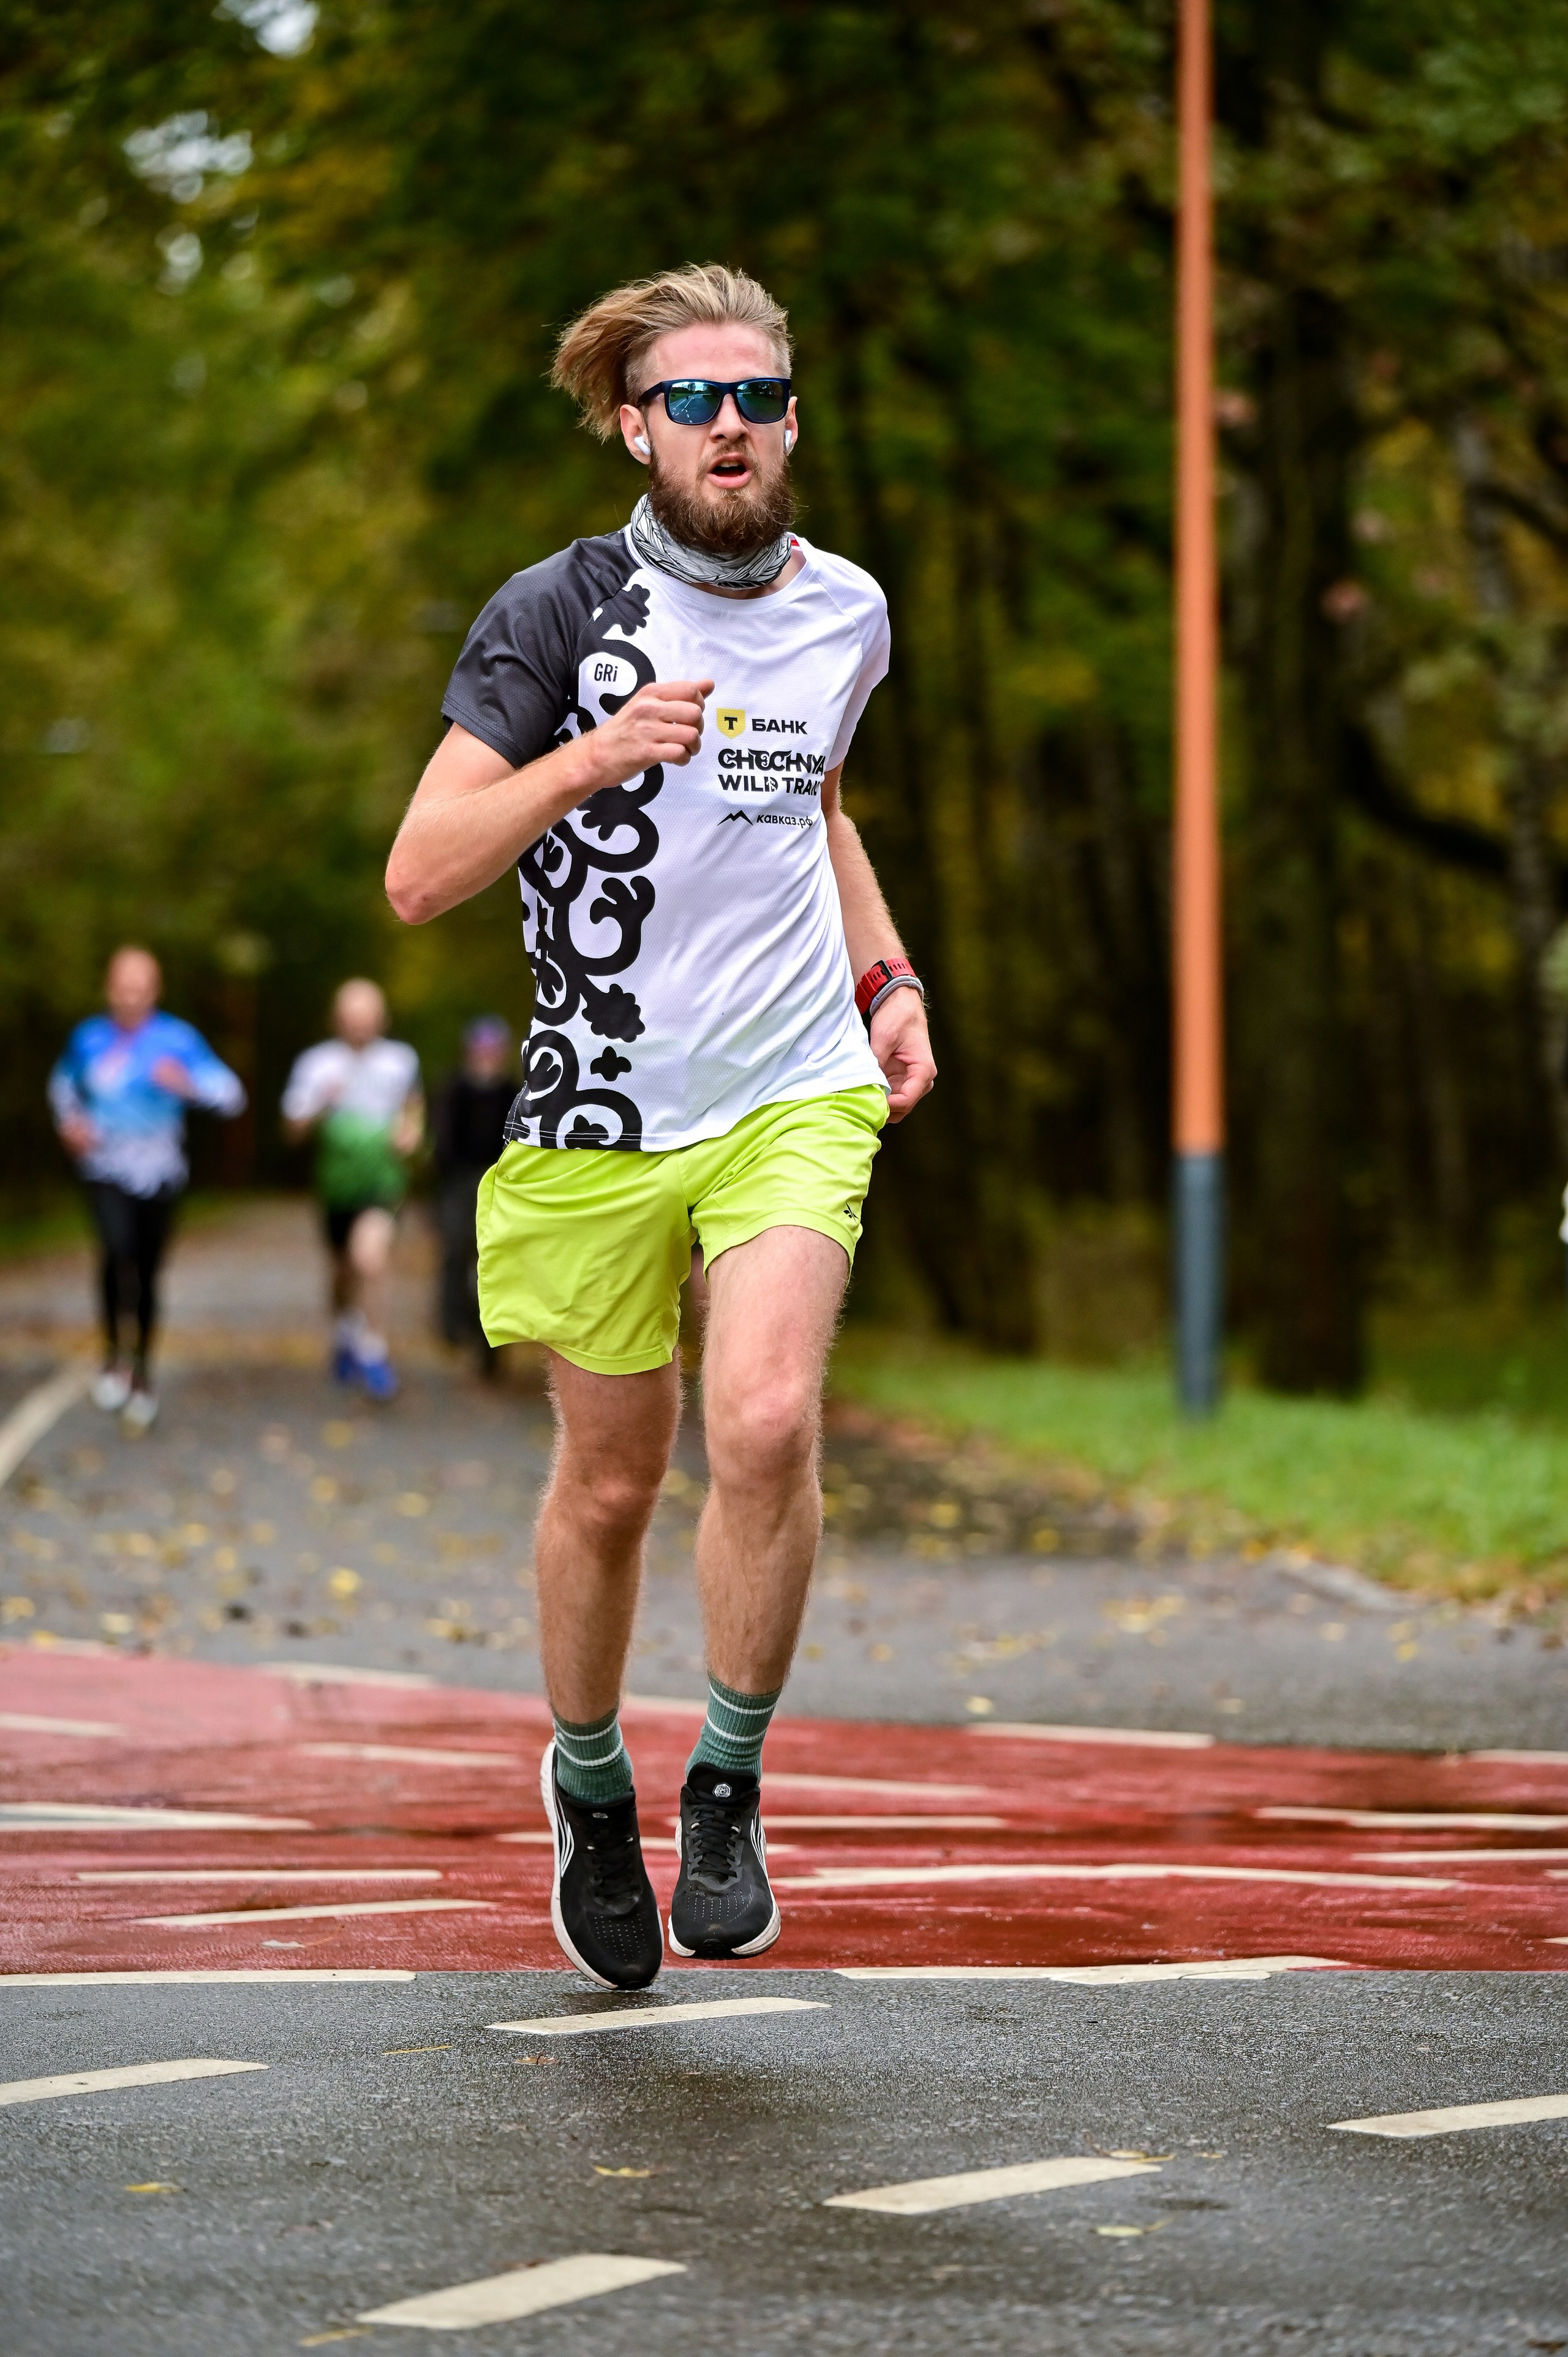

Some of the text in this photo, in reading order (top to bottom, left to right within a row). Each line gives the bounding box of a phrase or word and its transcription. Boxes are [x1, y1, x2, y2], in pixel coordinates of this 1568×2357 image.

[594, 663, 618, 682] GRi
[752, 718, 807, 734] БАНК
[718, 749, 826, 776] CHECHNYA
[718, 774, 778, 792] WILD
[756, 815, 813, 829] кавказ.рф
